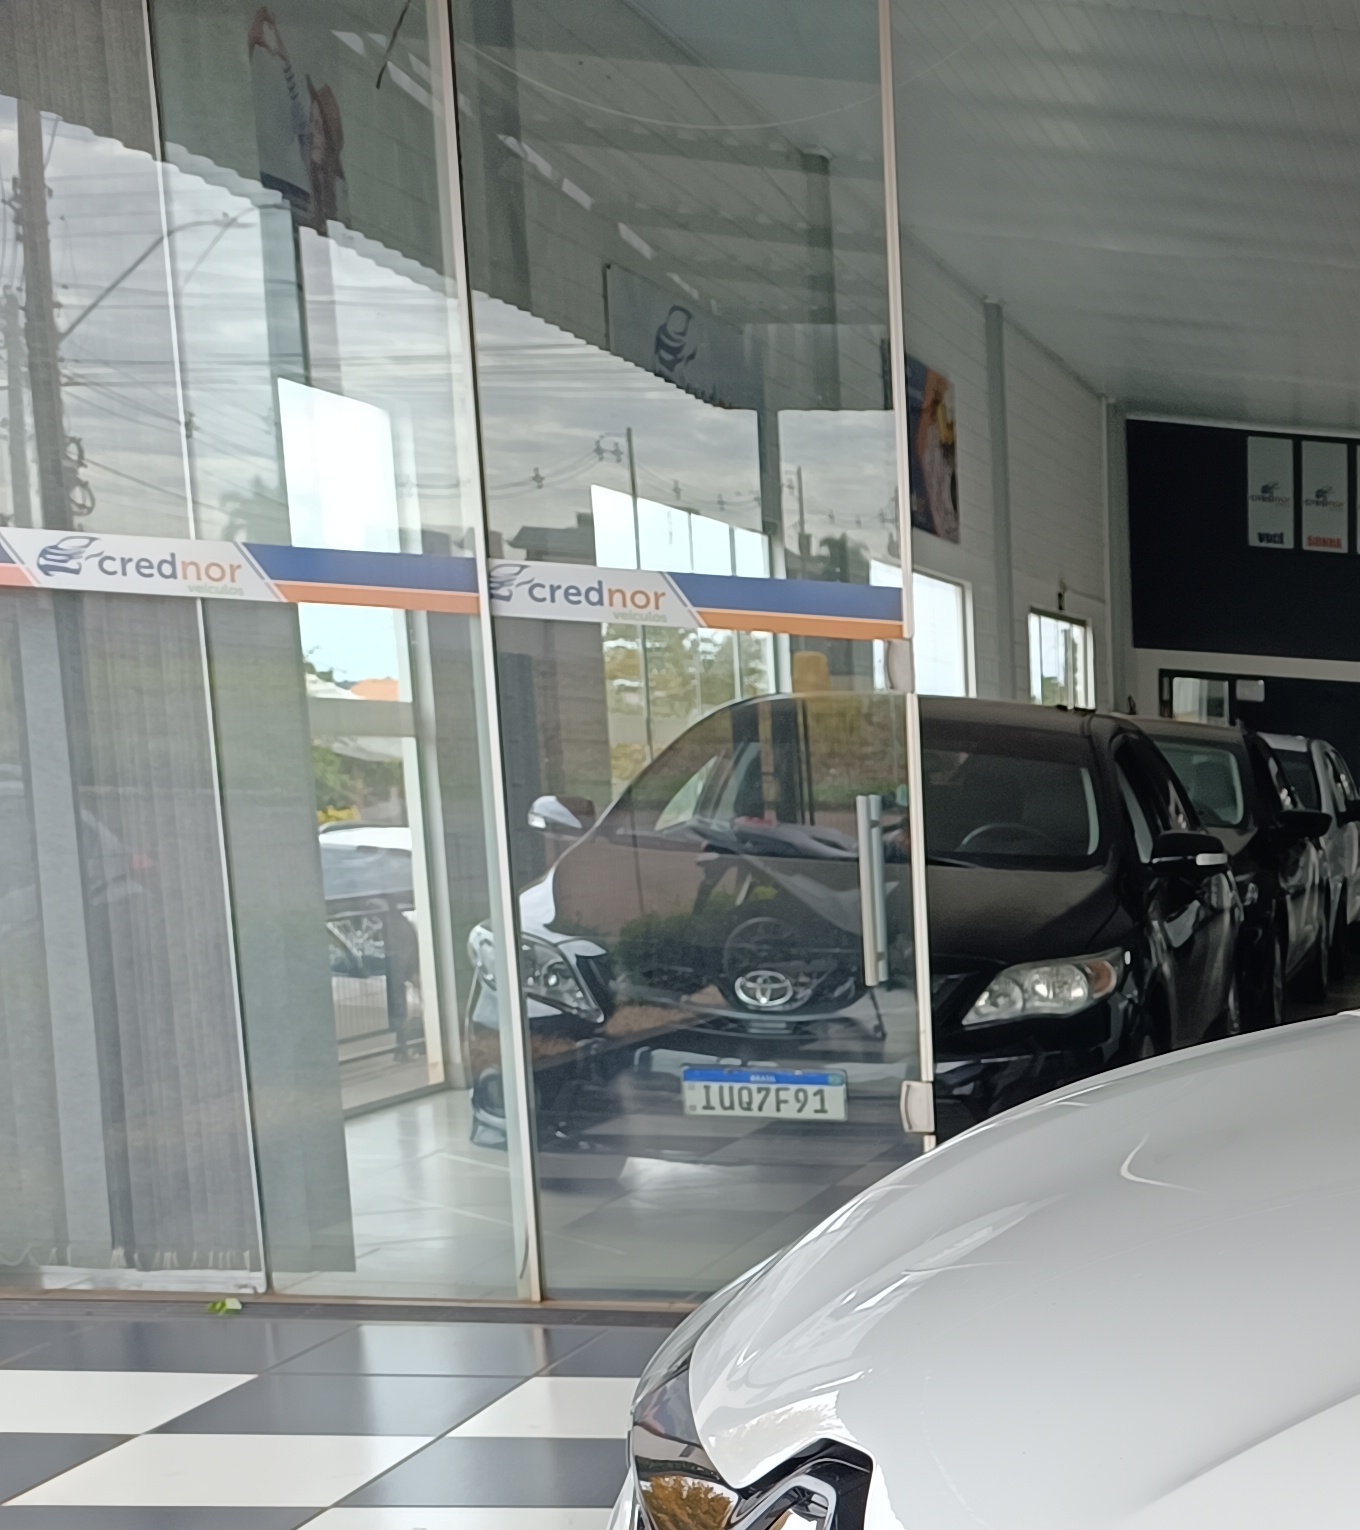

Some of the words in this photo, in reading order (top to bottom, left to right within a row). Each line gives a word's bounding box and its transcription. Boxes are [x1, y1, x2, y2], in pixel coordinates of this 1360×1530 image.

[97, 552, 241, 584] crednor
[528, 580, 666, 611] crednor
[702, 1085, 829, 1114] IUQ7F91
